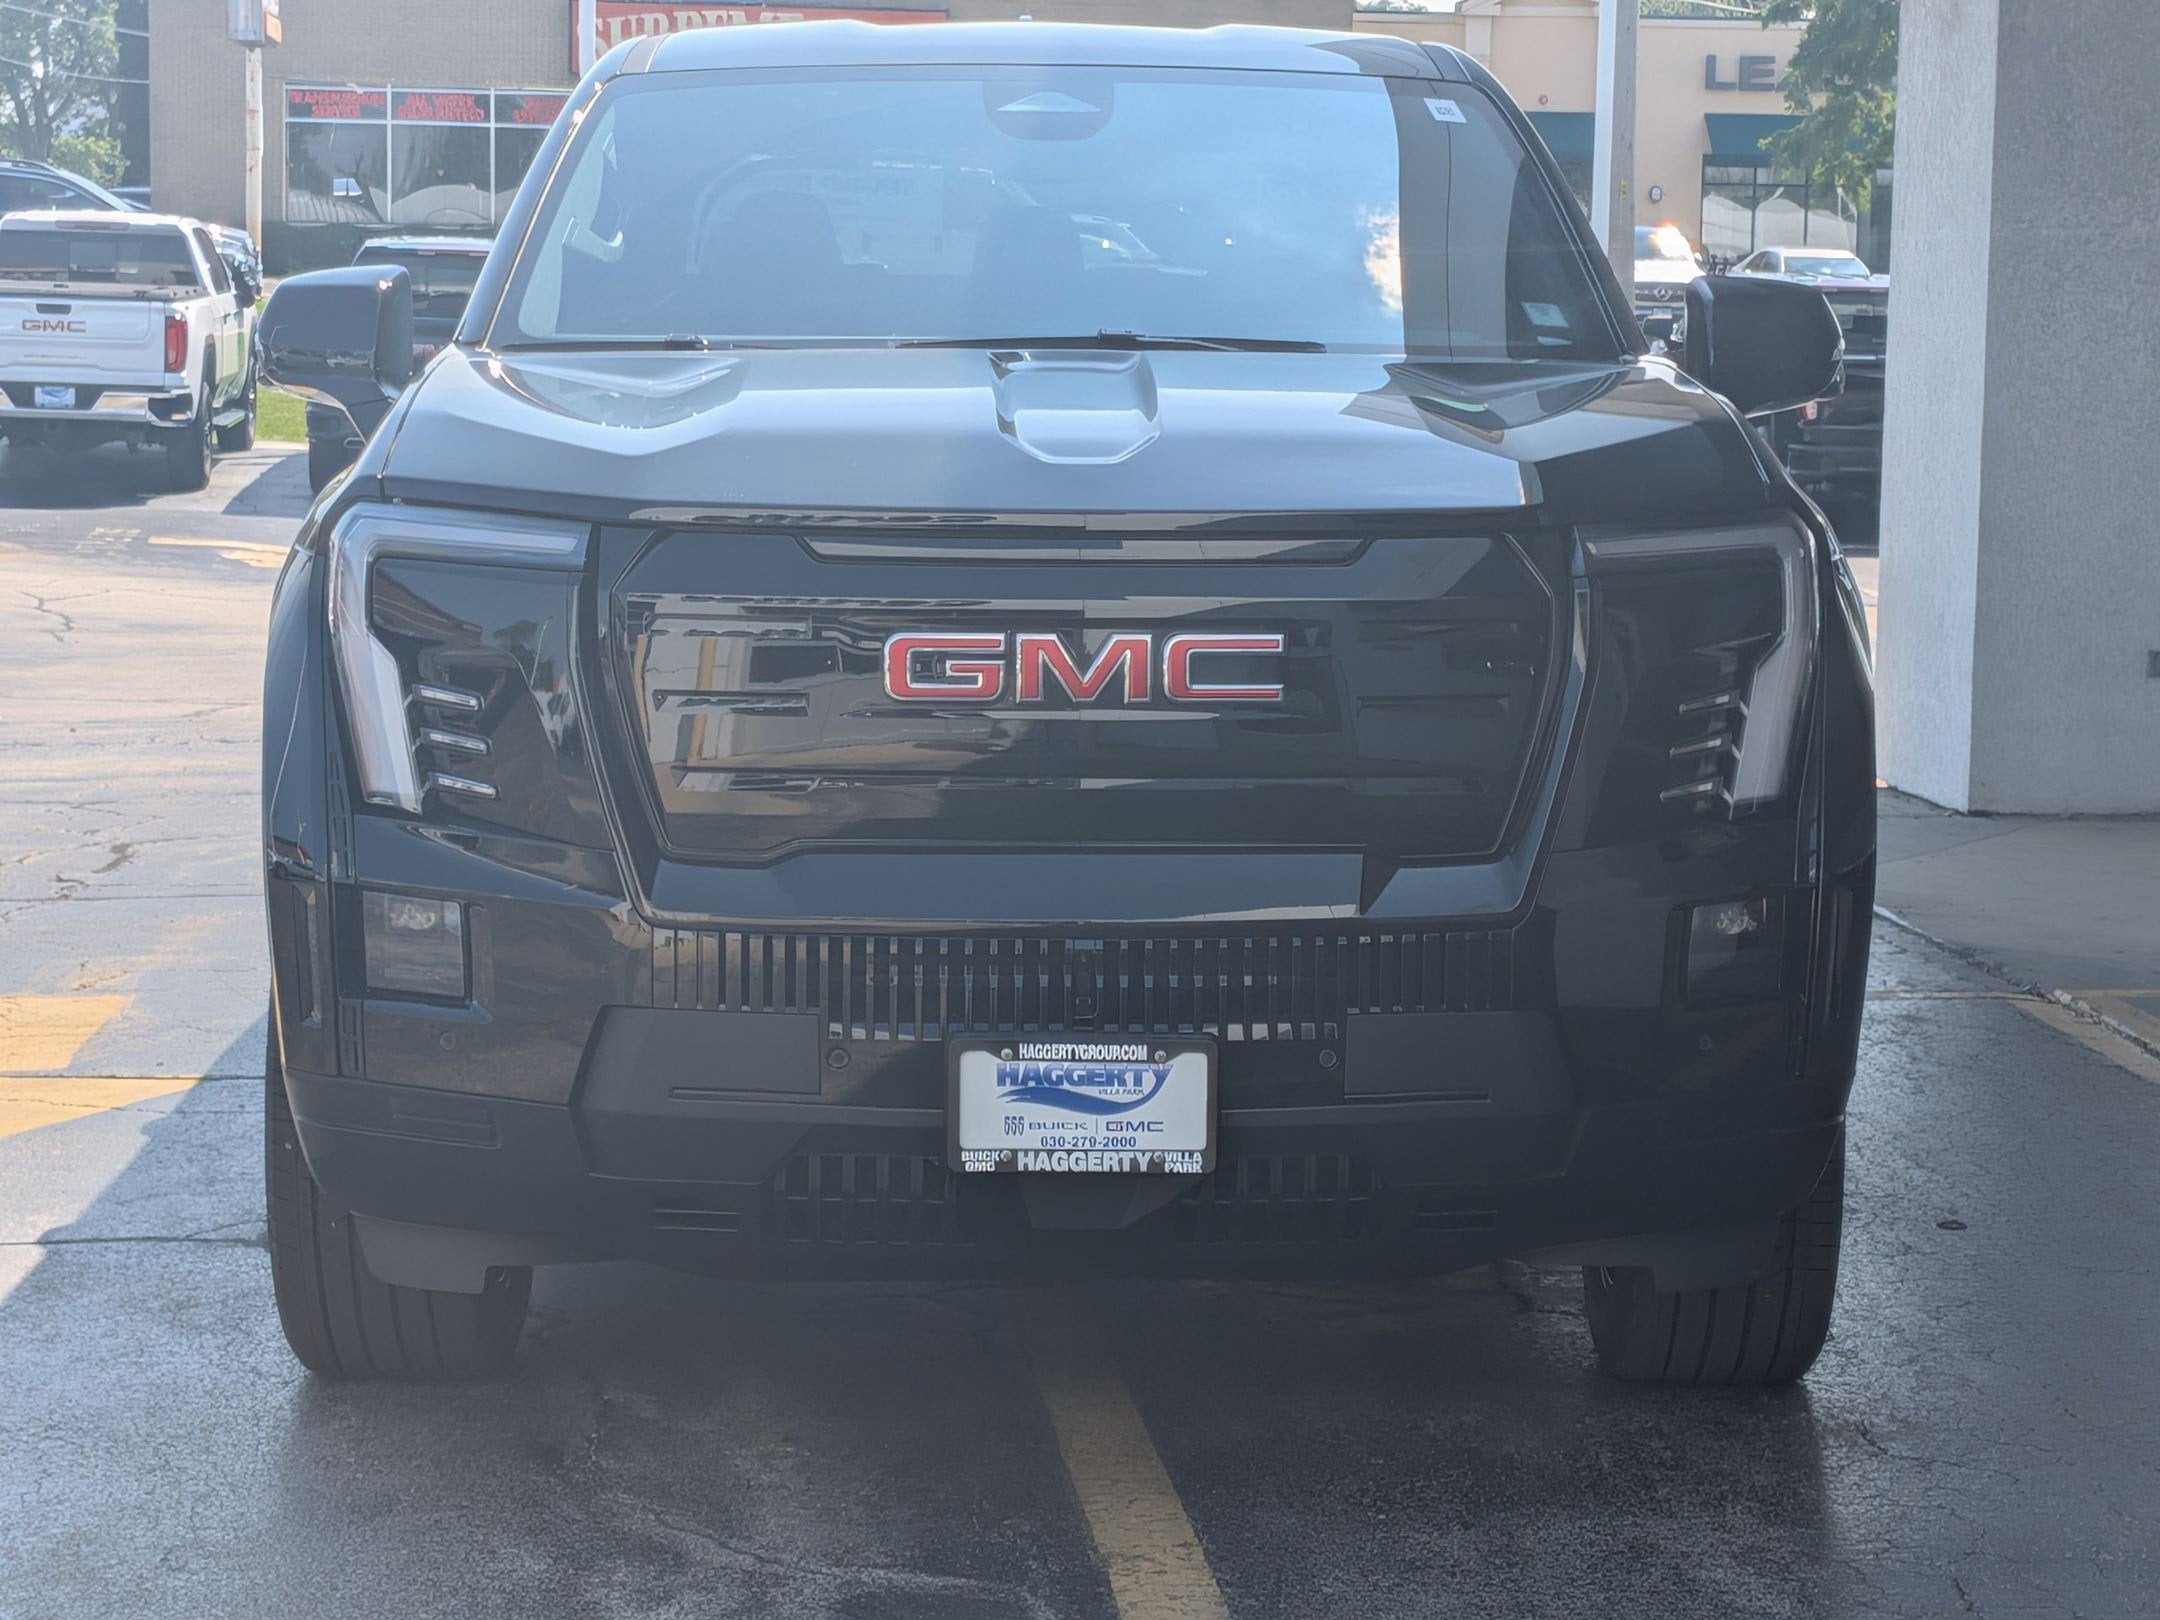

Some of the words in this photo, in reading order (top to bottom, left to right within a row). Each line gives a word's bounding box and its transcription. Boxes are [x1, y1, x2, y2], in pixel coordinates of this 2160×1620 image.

[1705, 54, 1790, 92] LE
[22, 319, 87, 333] GMC
[884, 632, 1285, 704] GMC
[996, 1063, 1174, 1088] HAGGERTY
[1098, 1088, 1121, 1096] VILLA
[1121, 1088, 1145, 1096] PARK
[1029, 1122, 1089, 1130] BUICK
[1106, 1121, 1164, 1132] GMC
[961, 1151, 1000, 1162] BUICK
[1017, 1151, 1154, 1173] HAGGERTY
[1164, 1152, 1202, 1162] VILLA
[1164, 1162, 1203, 1174] PARK
